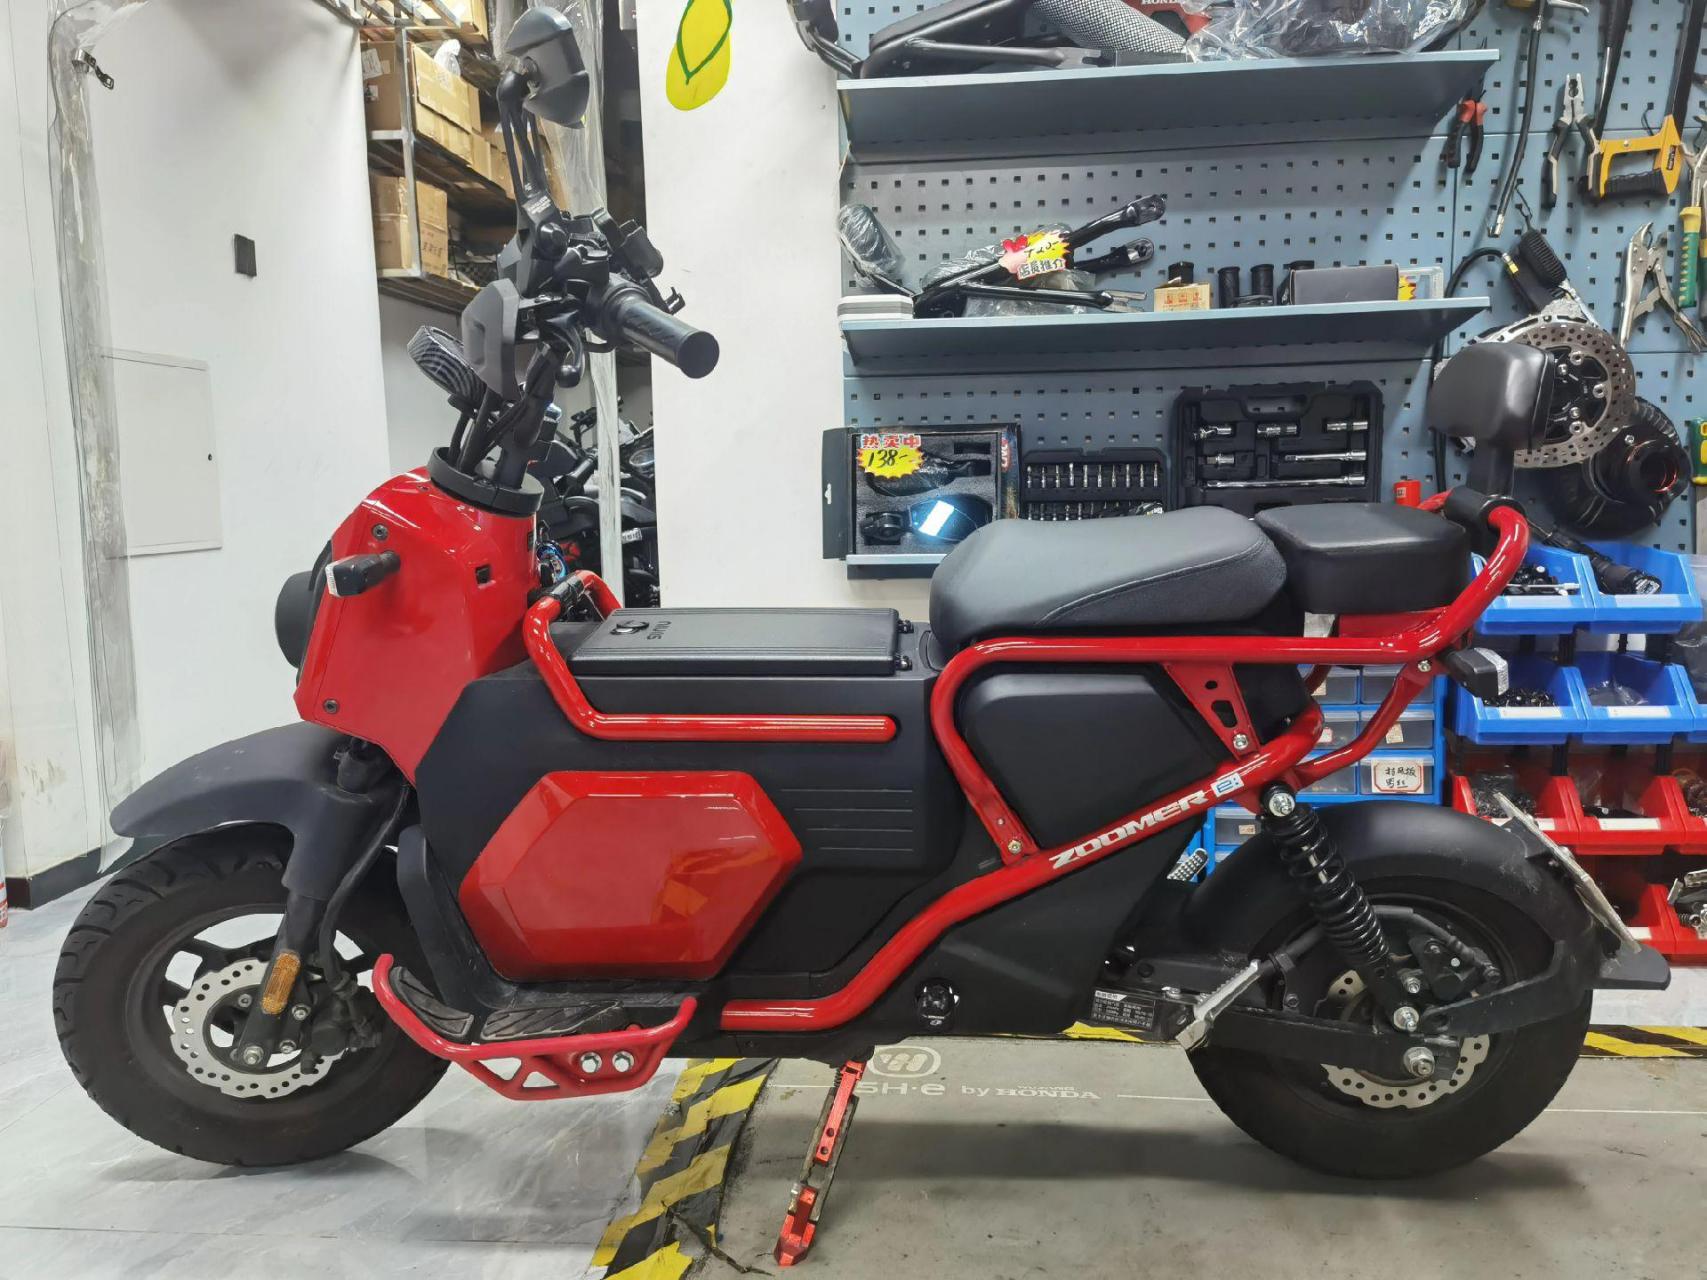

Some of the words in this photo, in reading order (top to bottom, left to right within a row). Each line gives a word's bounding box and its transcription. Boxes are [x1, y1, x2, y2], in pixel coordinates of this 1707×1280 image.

[1049, 790, 1208, 869] ZOOMER
[961, 1085, 991, 1097] by
[995, 1088, 1101, 1099] HONDA
